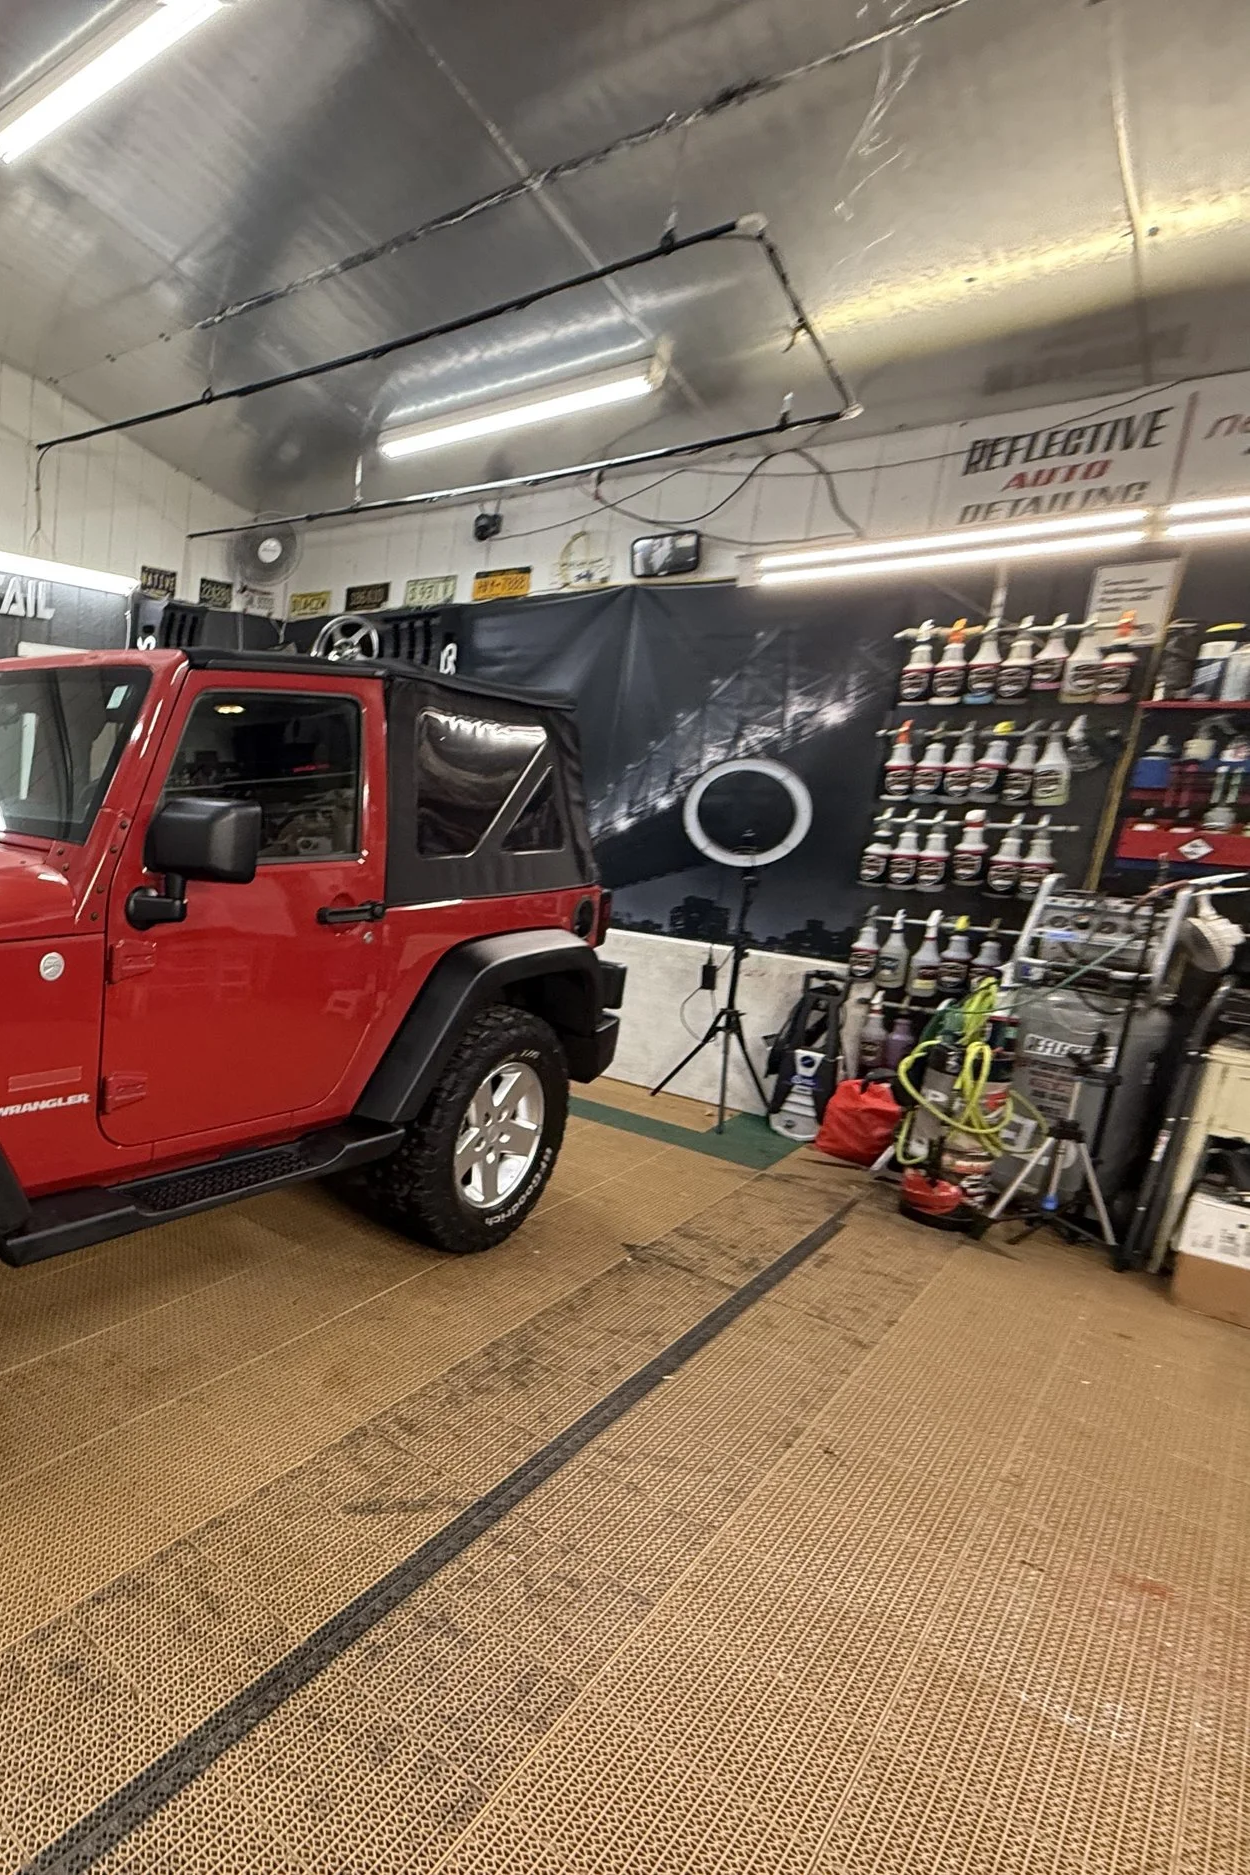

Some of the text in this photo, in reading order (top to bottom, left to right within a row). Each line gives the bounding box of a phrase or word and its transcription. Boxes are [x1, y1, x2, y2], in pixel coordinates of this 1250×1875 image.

[962, 406, 1174, 476] REFLECTIVE
[1001, 459, 1113, 492] AUTO
[957, 480, 1151, 525] DETAILING
